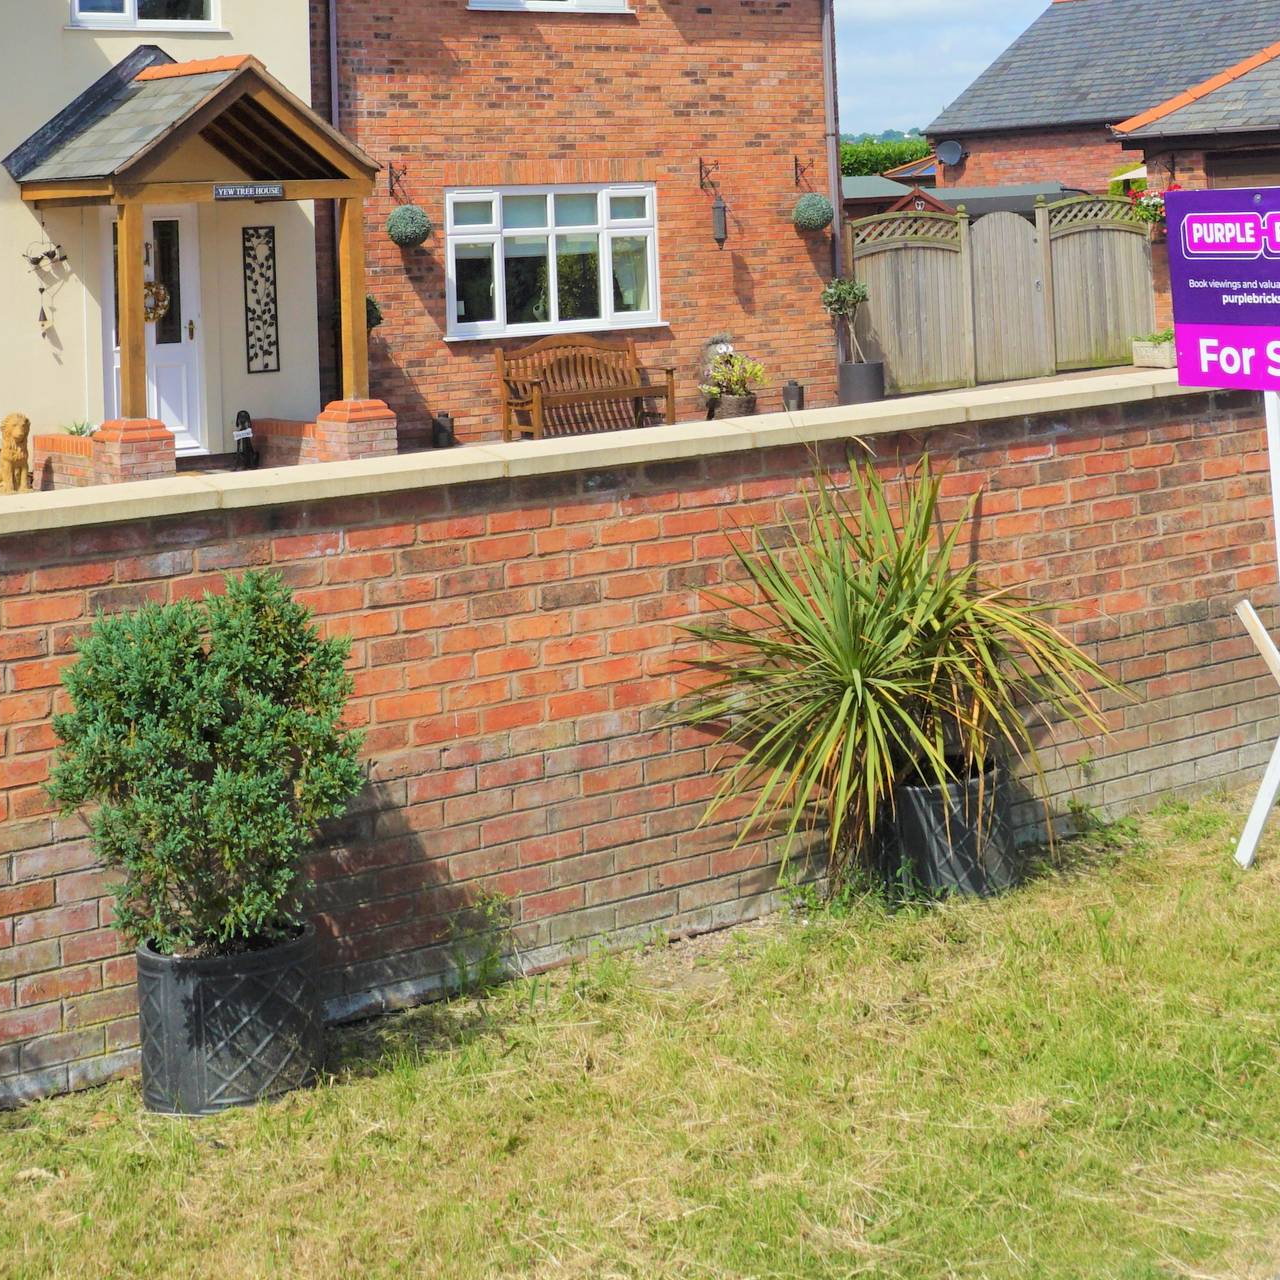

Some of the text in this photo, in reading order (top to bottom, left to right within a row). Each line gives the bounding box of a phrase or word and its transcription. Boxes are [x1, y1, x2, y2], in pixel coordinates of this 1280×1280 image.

[218, 186, 280, 196] YEW TREE HOUSE
[1192, 222, 1256, 244] PURPLE
[1189, 279, 1208, 288] Book
[1209, 279, 1241, 290] viewings
[1242, 280, 1258, 289] and
[1198, 338, 1256, 376] For
